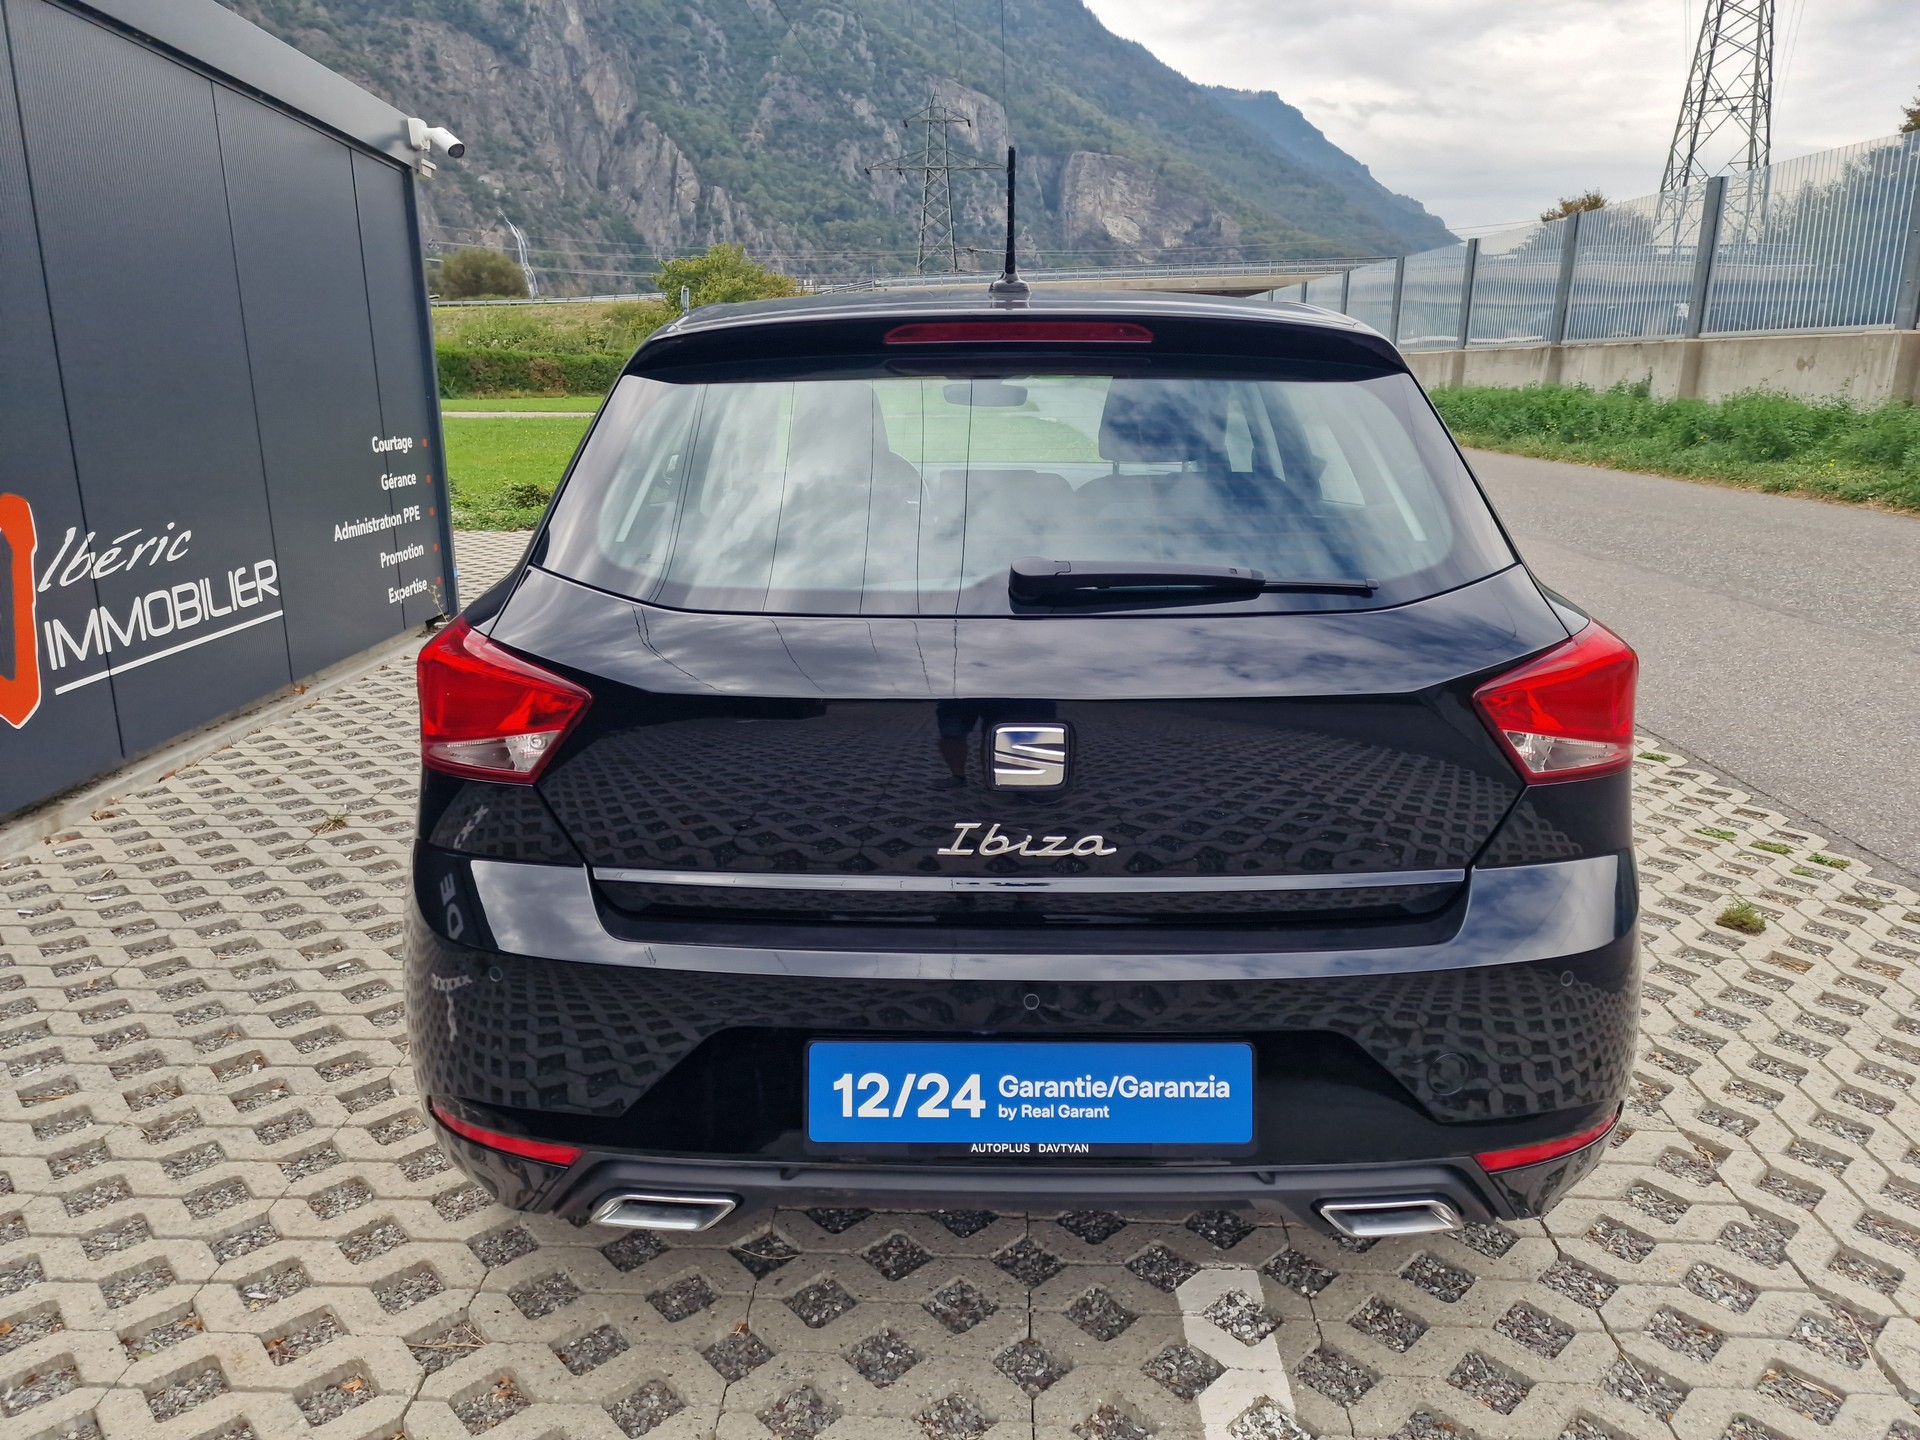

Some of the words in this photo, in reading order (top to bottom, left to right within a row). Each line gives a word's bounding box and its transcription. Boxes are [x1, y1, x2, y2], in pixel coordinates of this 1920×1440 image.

[371, 436, 413, 453] Courtage
[381, 472, 417, 491] Gérance
[333, 514, 402, 542] Administration
[403, 505, 421, 525] PPE
[380, 543, 425, 568] Promotion
[388, 577, 428, 604] Expertise
[44, 558, 280, 671] IMMOBILIER
[937, 822, 1117, 857] Ibiza
[833, 1072, 986, 1118] 12/24
[998, 1074, 1231, 1099] Garantie/Garanzia
[998, 1104, 1018, 1121] by
[1021, 1104, 1055, 1118] Real
[1057, 1104, 1110, 1118] Garant
[970, 1143, 1031, 1153] AUTOPLUS
[1038, 1143, 1089, 1153] DAVTYAN
